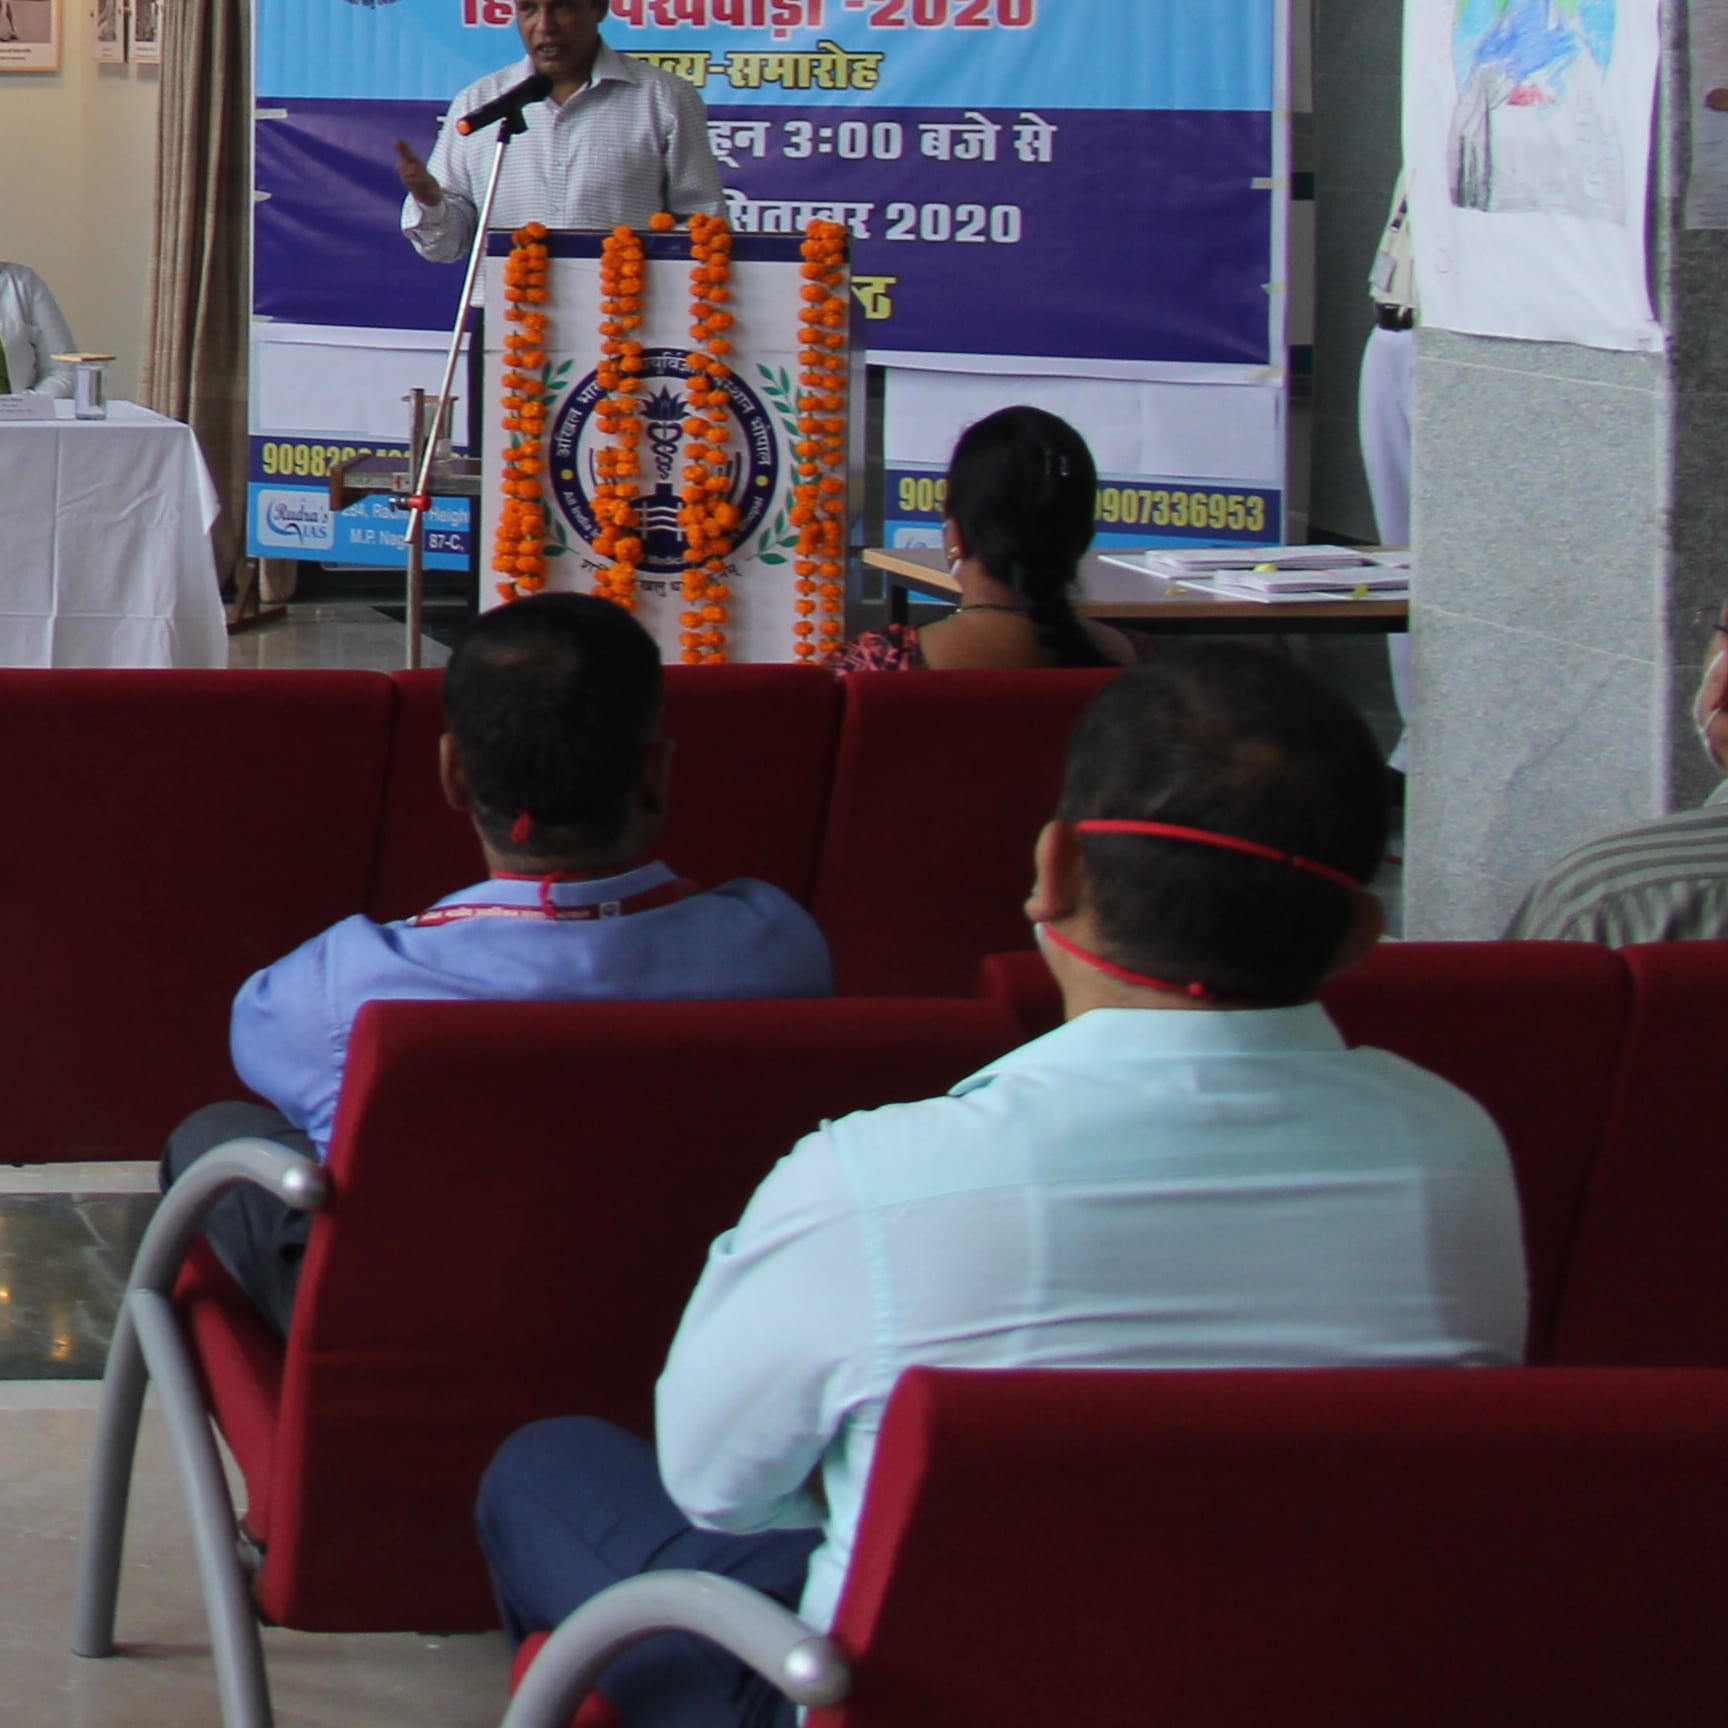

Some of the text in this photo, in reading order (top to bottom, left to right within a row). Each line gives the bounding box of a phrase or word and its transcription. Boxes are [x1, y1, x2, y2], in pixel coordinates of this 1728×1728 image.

[783, 119, 902, 161] 3:00
[919, 113, 1002, 162] बजे
[1013, 112, 1058, 163] से
[885, 202, 1022, 244] 2020
[1095, 487, 1266, 533] 907336953
[302, 526, 327, 539] IAS
